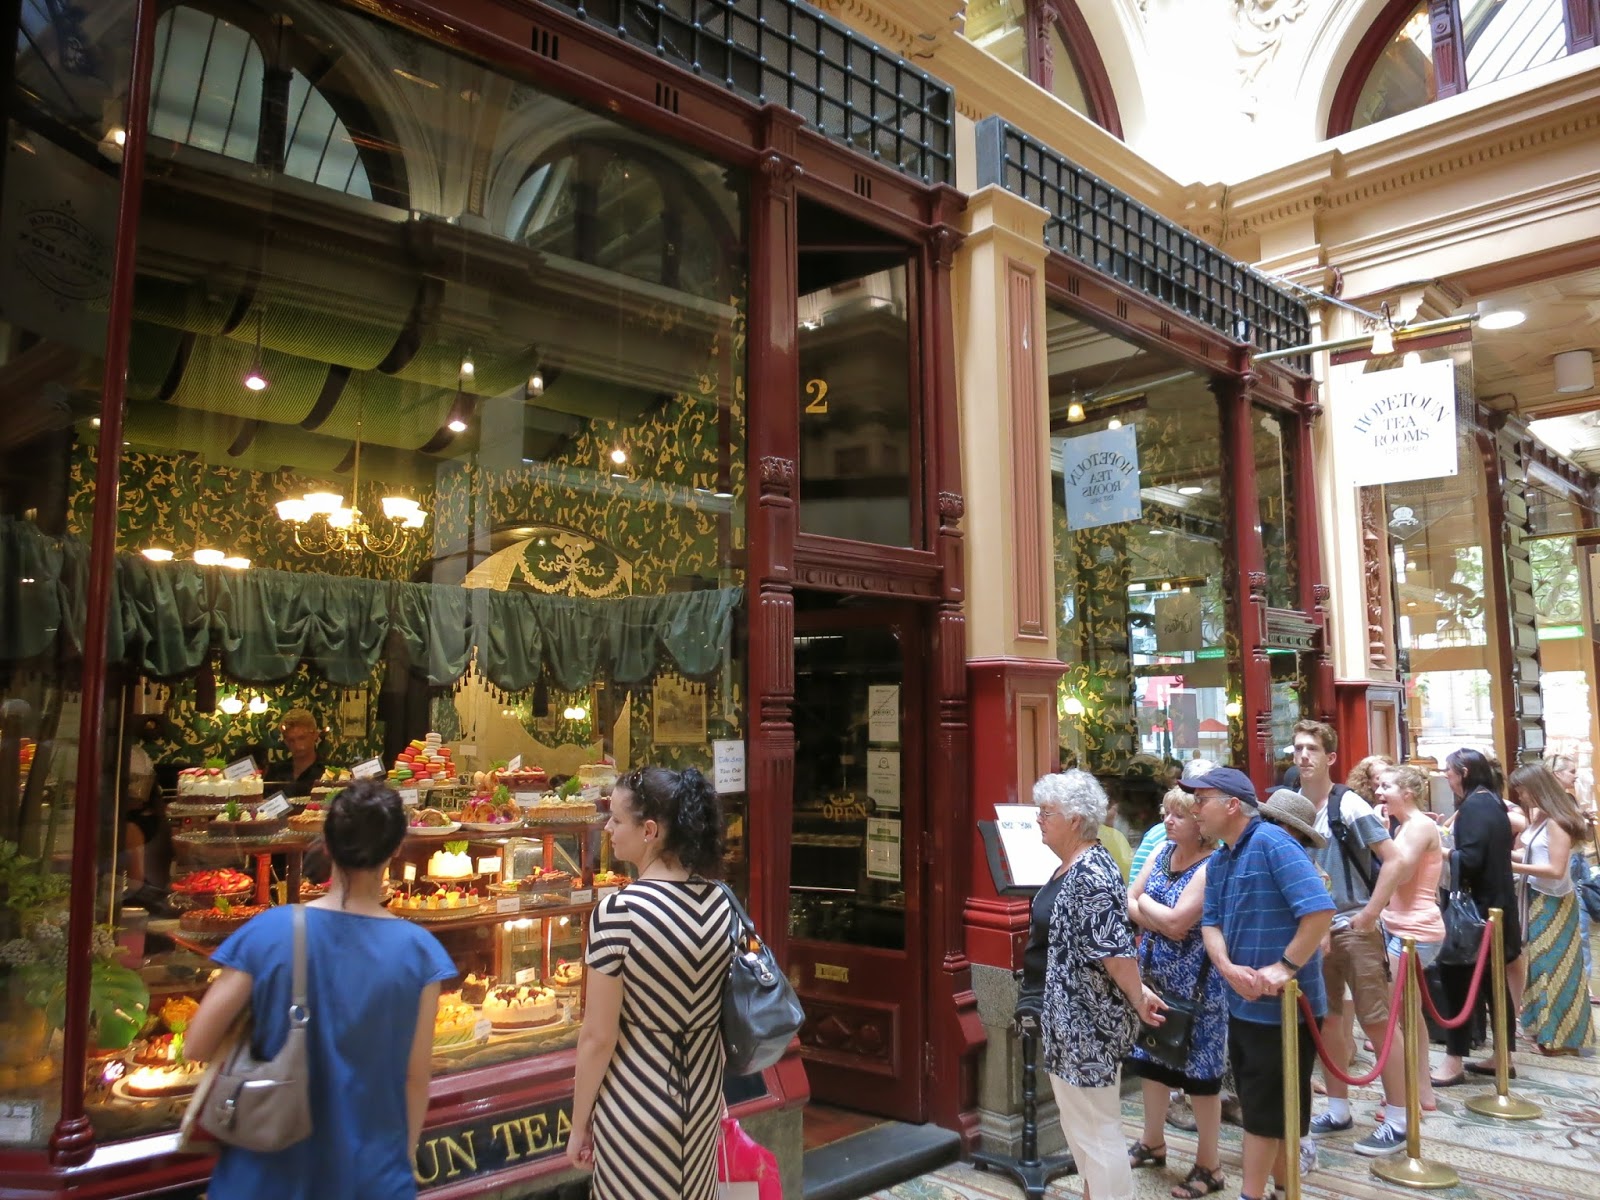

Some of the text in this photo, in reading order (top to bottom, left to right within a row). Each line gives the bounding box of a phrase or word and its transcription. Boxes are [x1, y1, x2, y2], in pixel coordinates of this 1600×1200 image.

[805, 379, 828, 414] 2
[1353, 392, 1450, 434] HOPETOUN
[1383, 415, 1416, 431] TEA
[1374, 427, 1430, 447] ROOMS
[823, 802, 868, 822] OPEN
[491, 1108, 573, 1162] TEA
